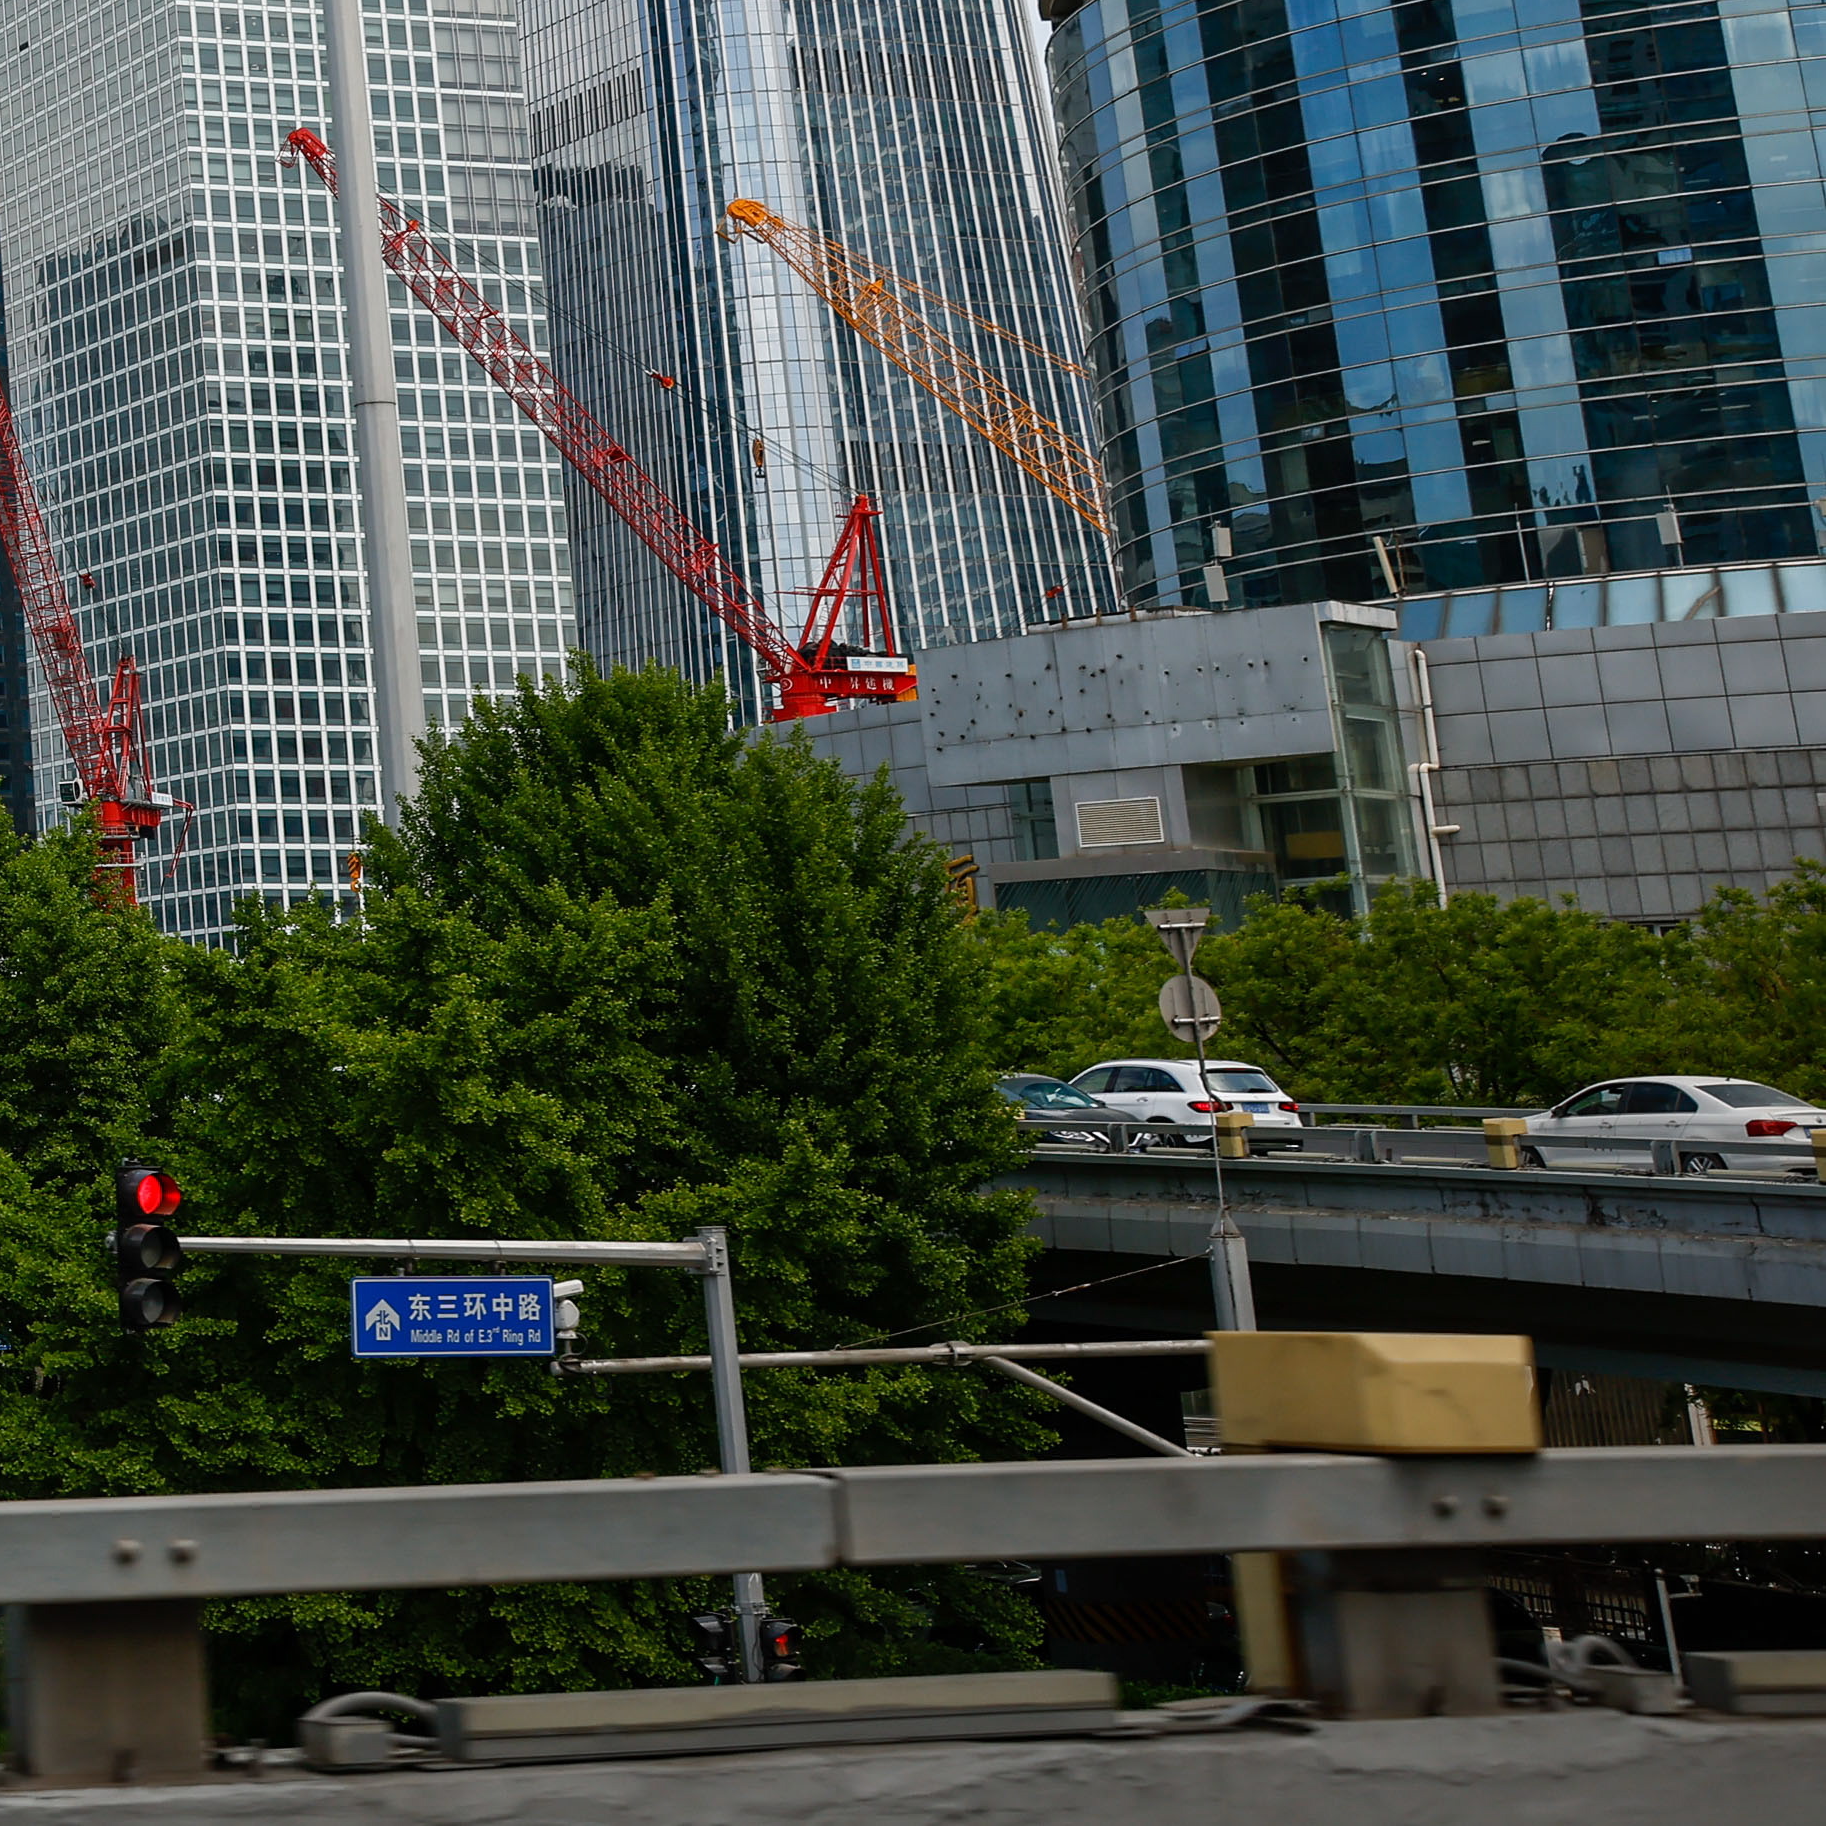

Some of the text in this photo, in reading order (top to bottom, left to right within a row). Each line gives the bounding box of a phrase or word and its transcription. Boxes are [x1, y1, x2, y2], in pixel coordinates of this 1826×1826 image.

[407, 1292, 542, 1321] 东三环中路
[376, 1310, 389, 1325] 北
[379, 1327, 389, 1338] N
[410, 1329, 443, 1343] Middle
[447, 1329, 460, 1343] Rd
[464, 1329, 474, 1343] of
[502, 1328, 524, 1346] Ring
[528, 1328, 541, 1343] Rd
